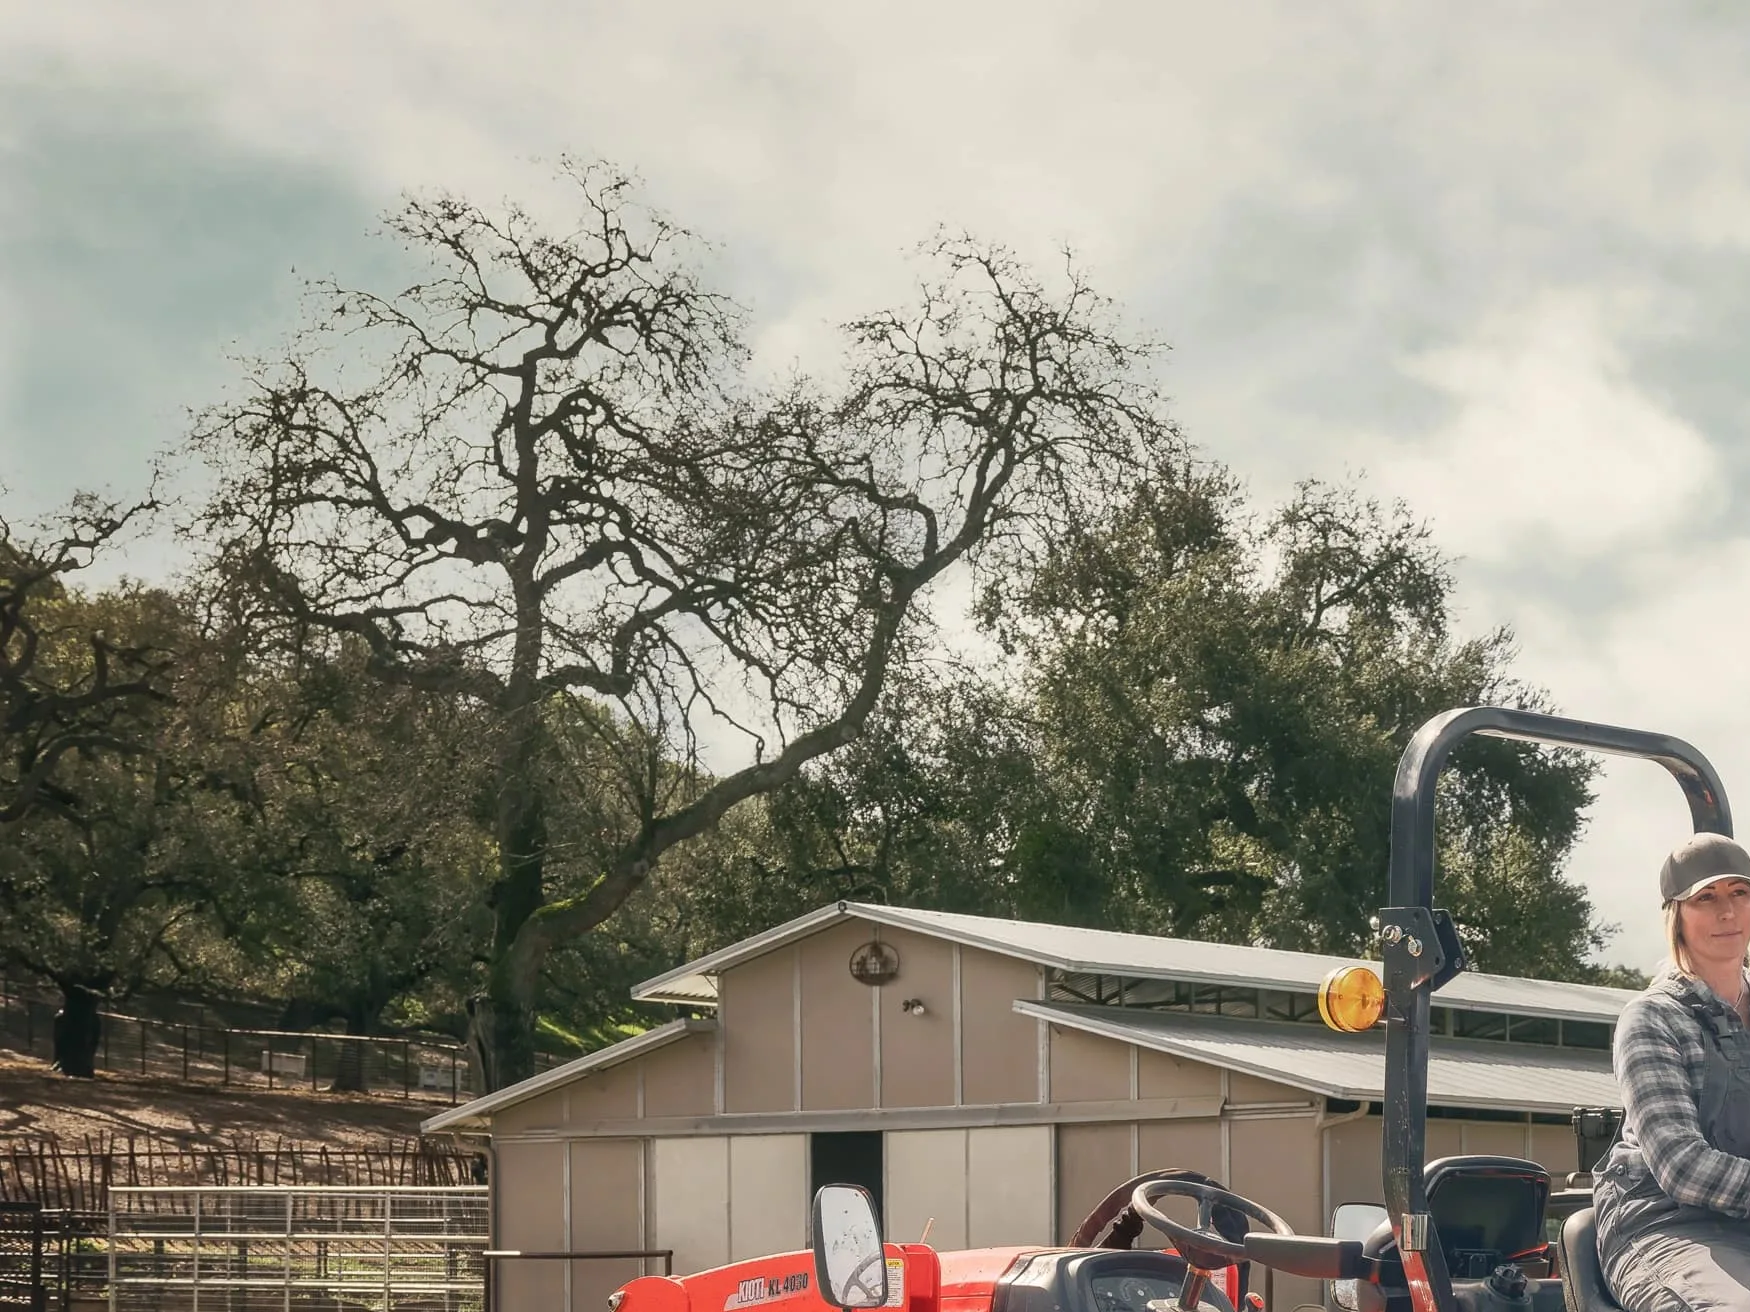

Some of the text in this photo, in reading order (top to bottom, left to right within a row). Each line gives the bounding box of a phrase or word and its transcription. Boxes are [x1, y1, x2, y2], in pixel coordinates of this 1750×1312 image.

[738, 1273, 808, 1303] KIOTI KL 4030
